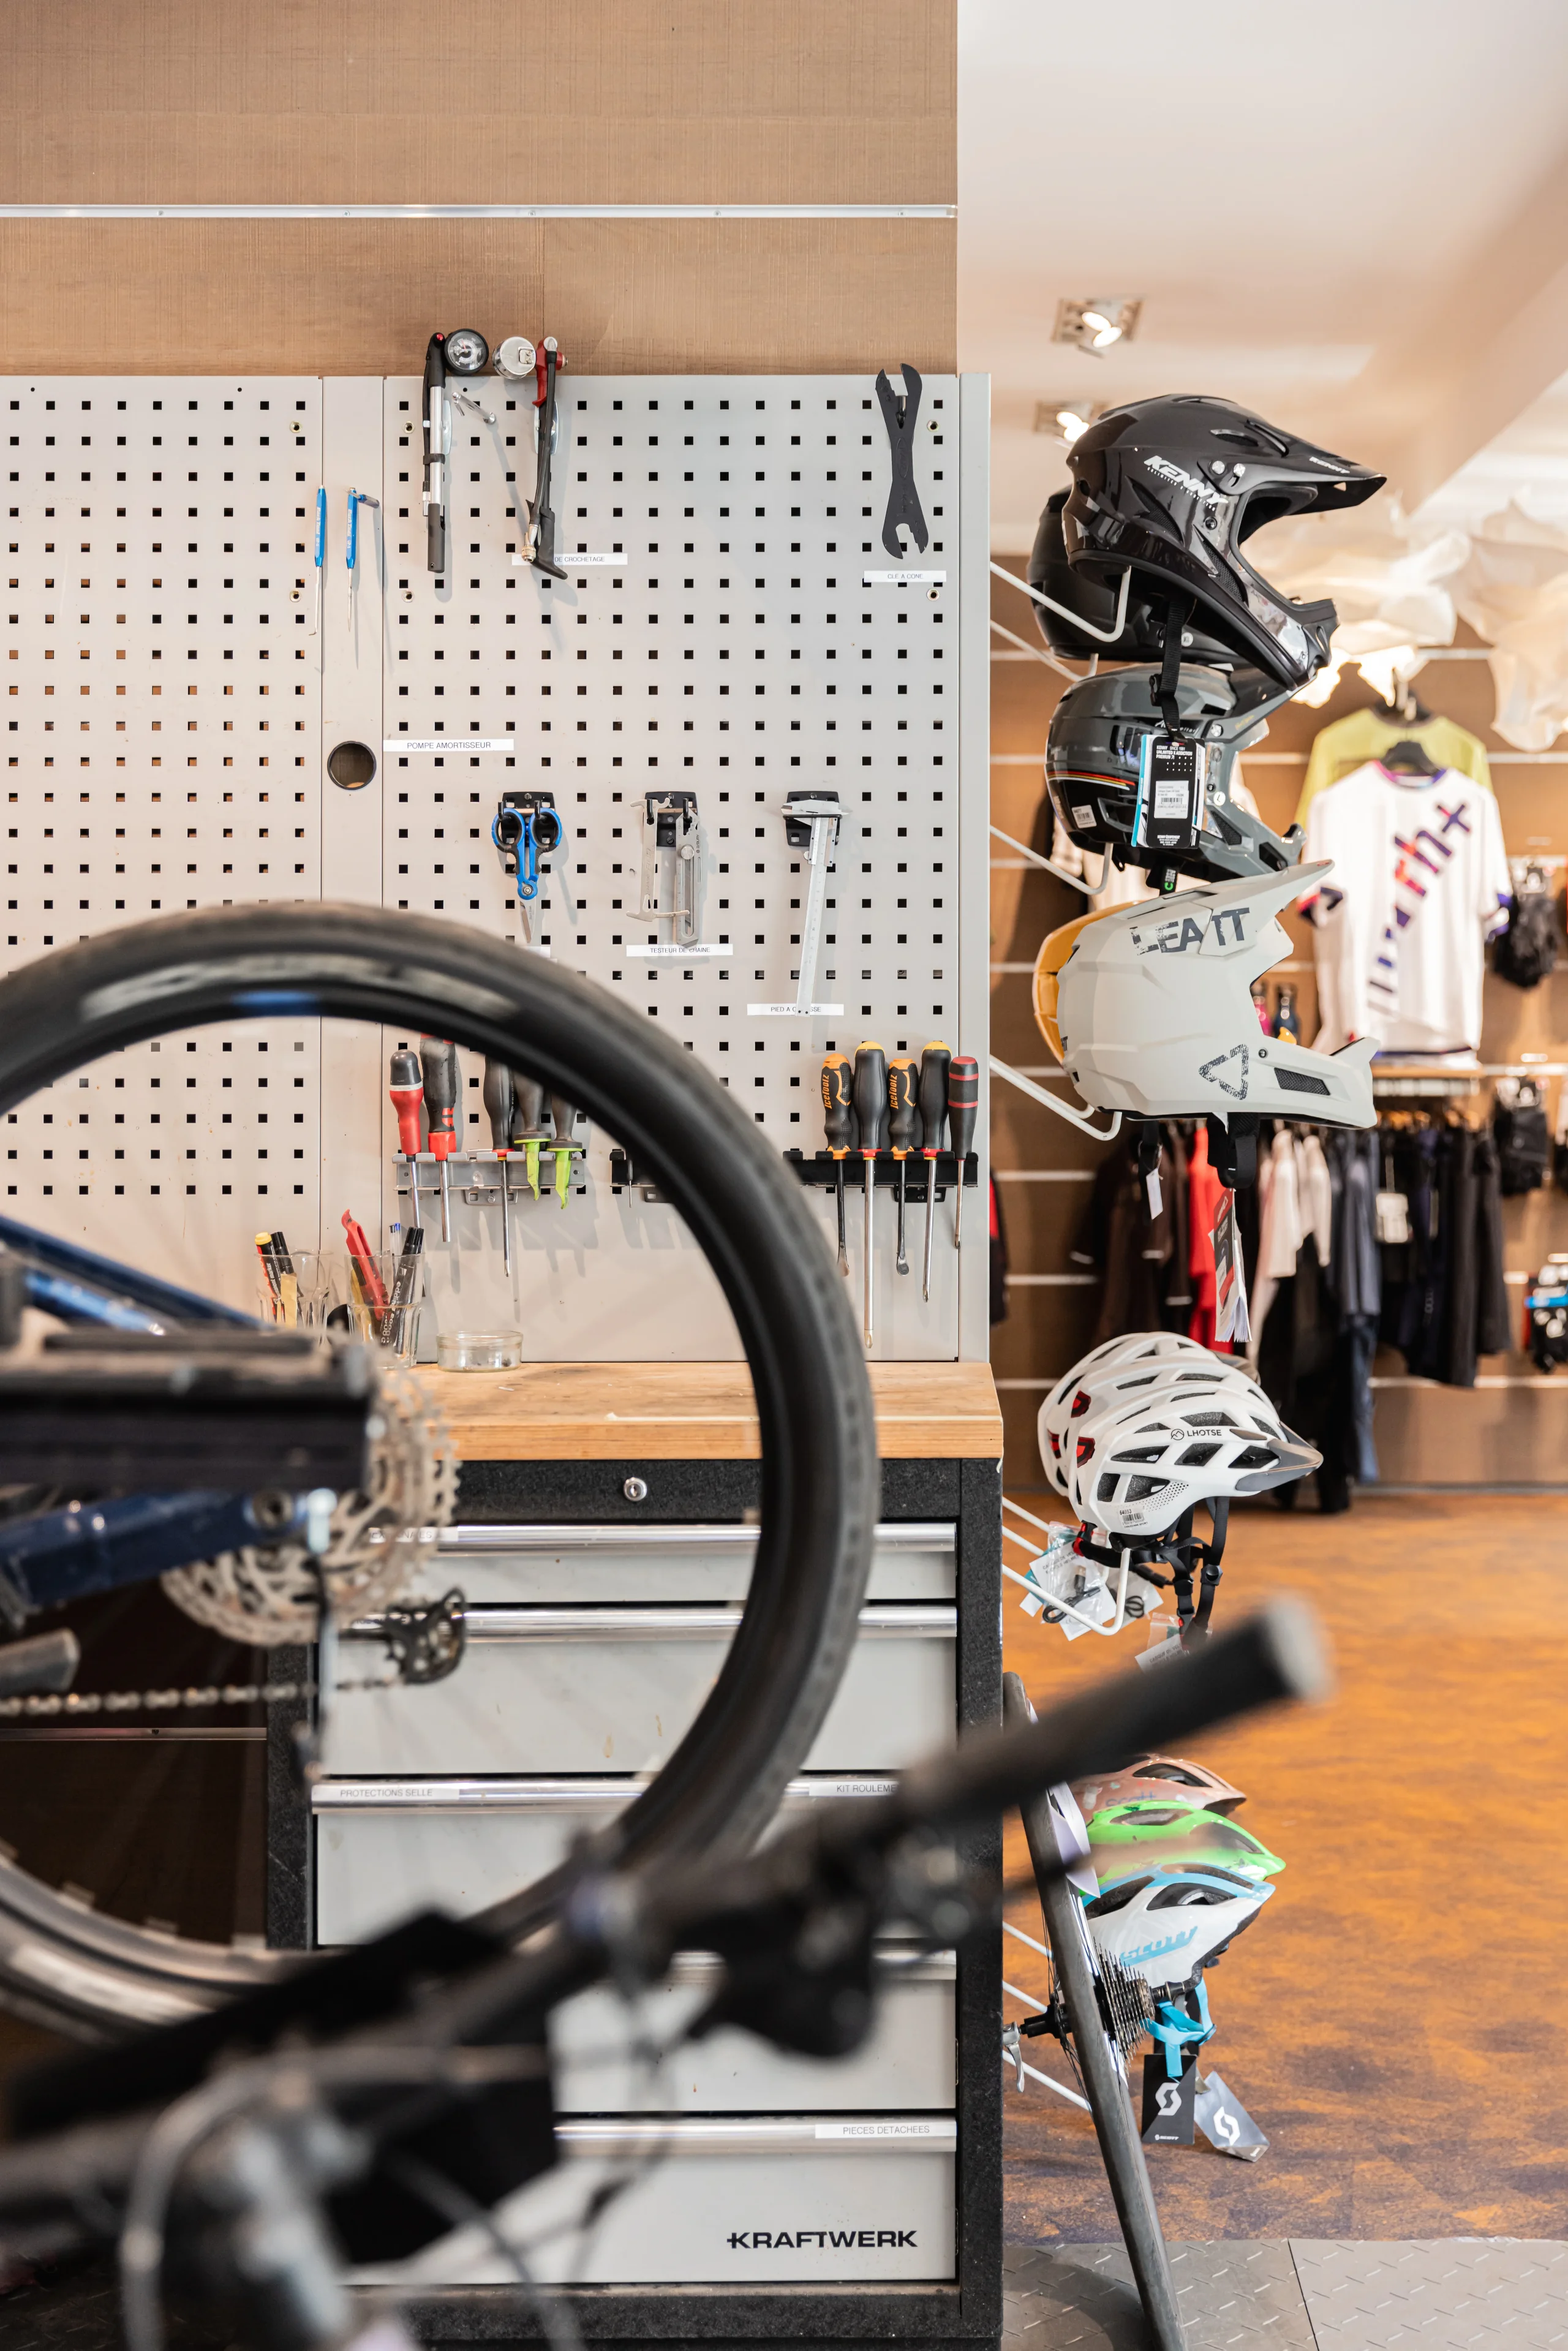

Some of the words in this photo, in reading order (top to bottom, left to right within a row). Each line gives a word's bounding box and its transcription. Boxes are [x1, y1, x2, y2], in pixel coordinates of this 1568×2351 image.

[1144, 455, 1229, 505] KENNY
[1129, 907, 1250, 956] LEATT
[822, 1074, 832, 1109] IceToolz
[889, 1074, 899, 1109] IceToolz
[340, 1788, 404, 1797] PROTECTIONS
[853, 1784, 897, 1792] ROULEME
[843, 2126, 875, 2135] PIECES
[877, 2125, 930, 2134] DETACHEES
[727, 2230, 918, 2249] KRAFTWERK
